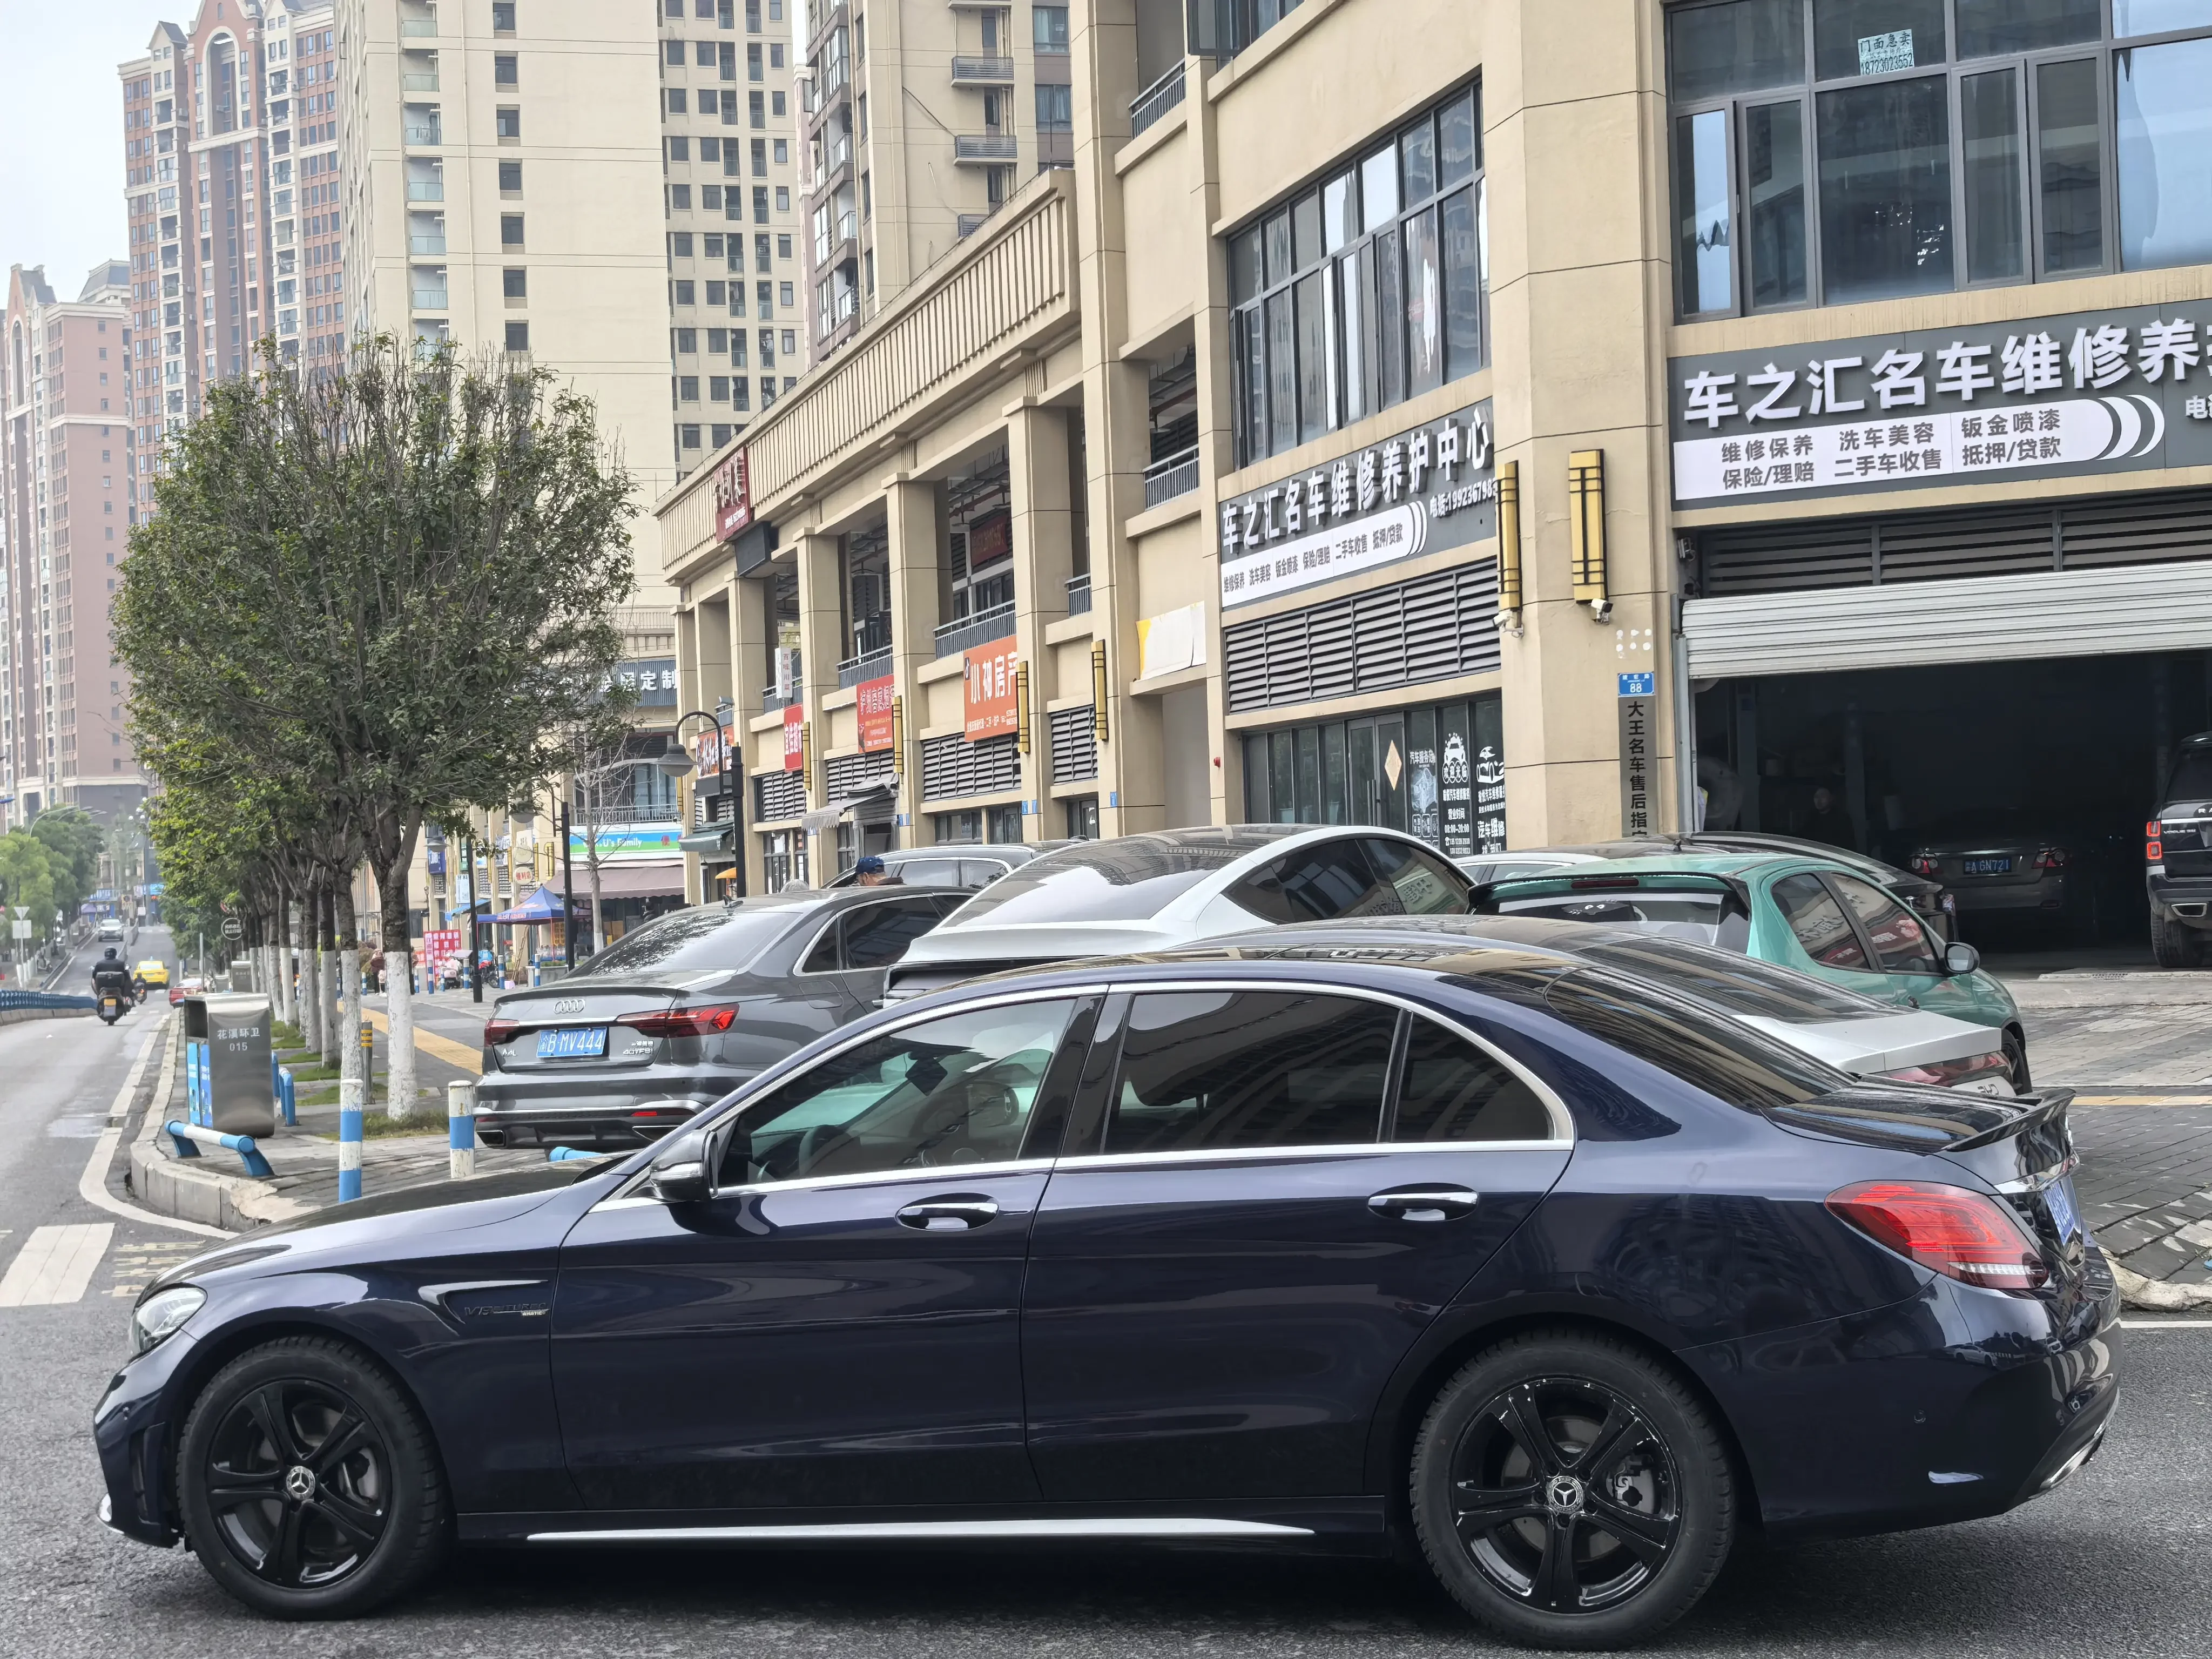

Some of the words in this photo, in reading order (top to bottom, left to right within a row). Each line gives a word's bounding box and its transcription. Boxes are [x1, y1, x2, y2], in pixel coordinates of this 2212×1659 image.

[1860, 31, 1911, 52] 门面急卖
[1684, 318, 2212, 429] 车之汇名车维修养
[2186, 395, 2212, 419] 电
[1722, 434, 1813, 463] 维修保养
[1839, 422, 1934, 451] 洗车美容
[1961, 409, 2061, 439] 钣金喷漆
[1223, 406, 1491, 554] 车之汇名车维修养护中心
[1723, 461, 1815, 490] 保险/理赔
[1835, 449, 1941, 478] 二手车收售
[1962, 436, 2061, 467] 抵押/贷款
[1224, 571, 1245, 594] 维修保养
[1249, 564, 1271, 586] 洗车美容
[1275, 555, 1298, 578] 钣金喷漆
[1303, 545, 1331, 571] 保险/理赔
[1336, 534, 1368, 559] 二手车收售
[1372, 522, 1404, 550] 抵押/贷款
[1630, 683, 1642, 693] 88
[217, 1027, 260, 1040] 花溪环卫
[230, 1042, 248, 1051] 015
